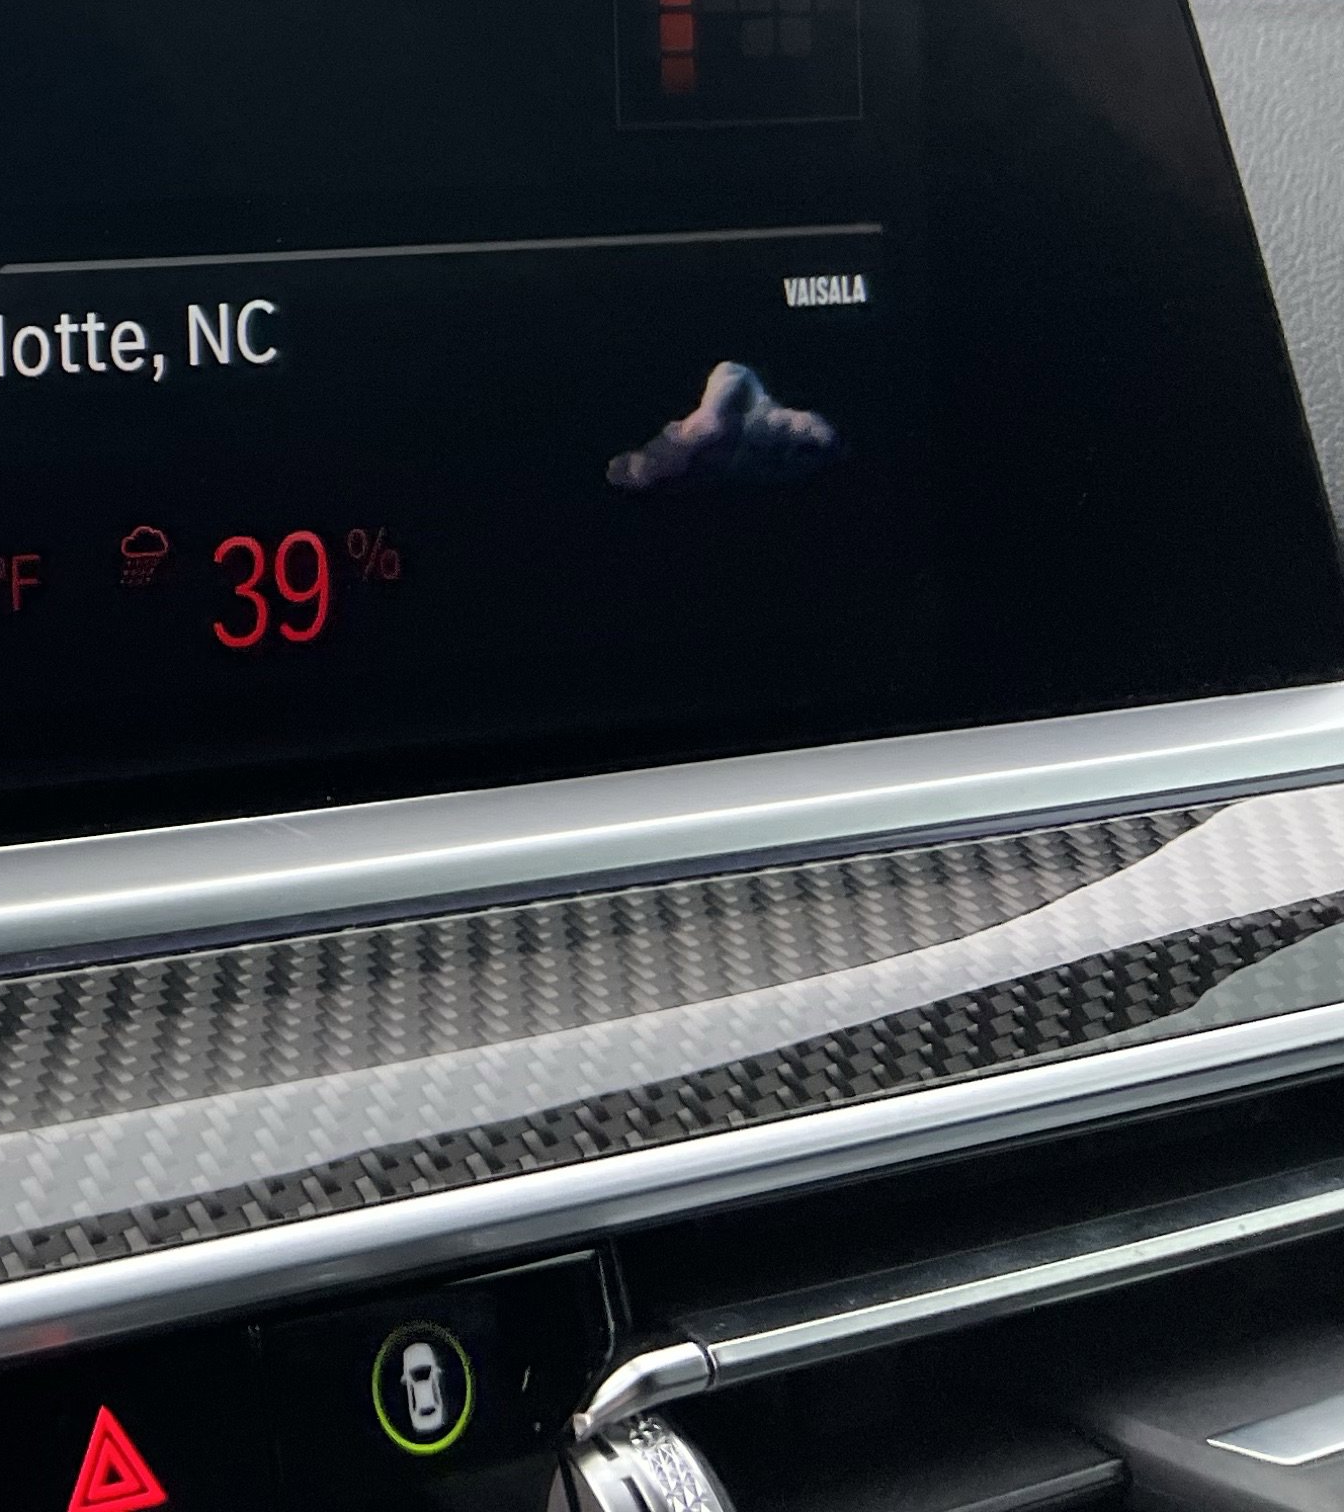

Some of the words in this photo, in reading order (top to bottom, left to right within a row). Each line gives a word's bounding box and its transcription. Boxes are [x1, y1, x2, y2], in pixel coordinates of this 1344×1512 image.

[783, 274, 866, 307] VAISALA
[187, 298, 280, 366] NC
[214, 530, 330, 649] 39
